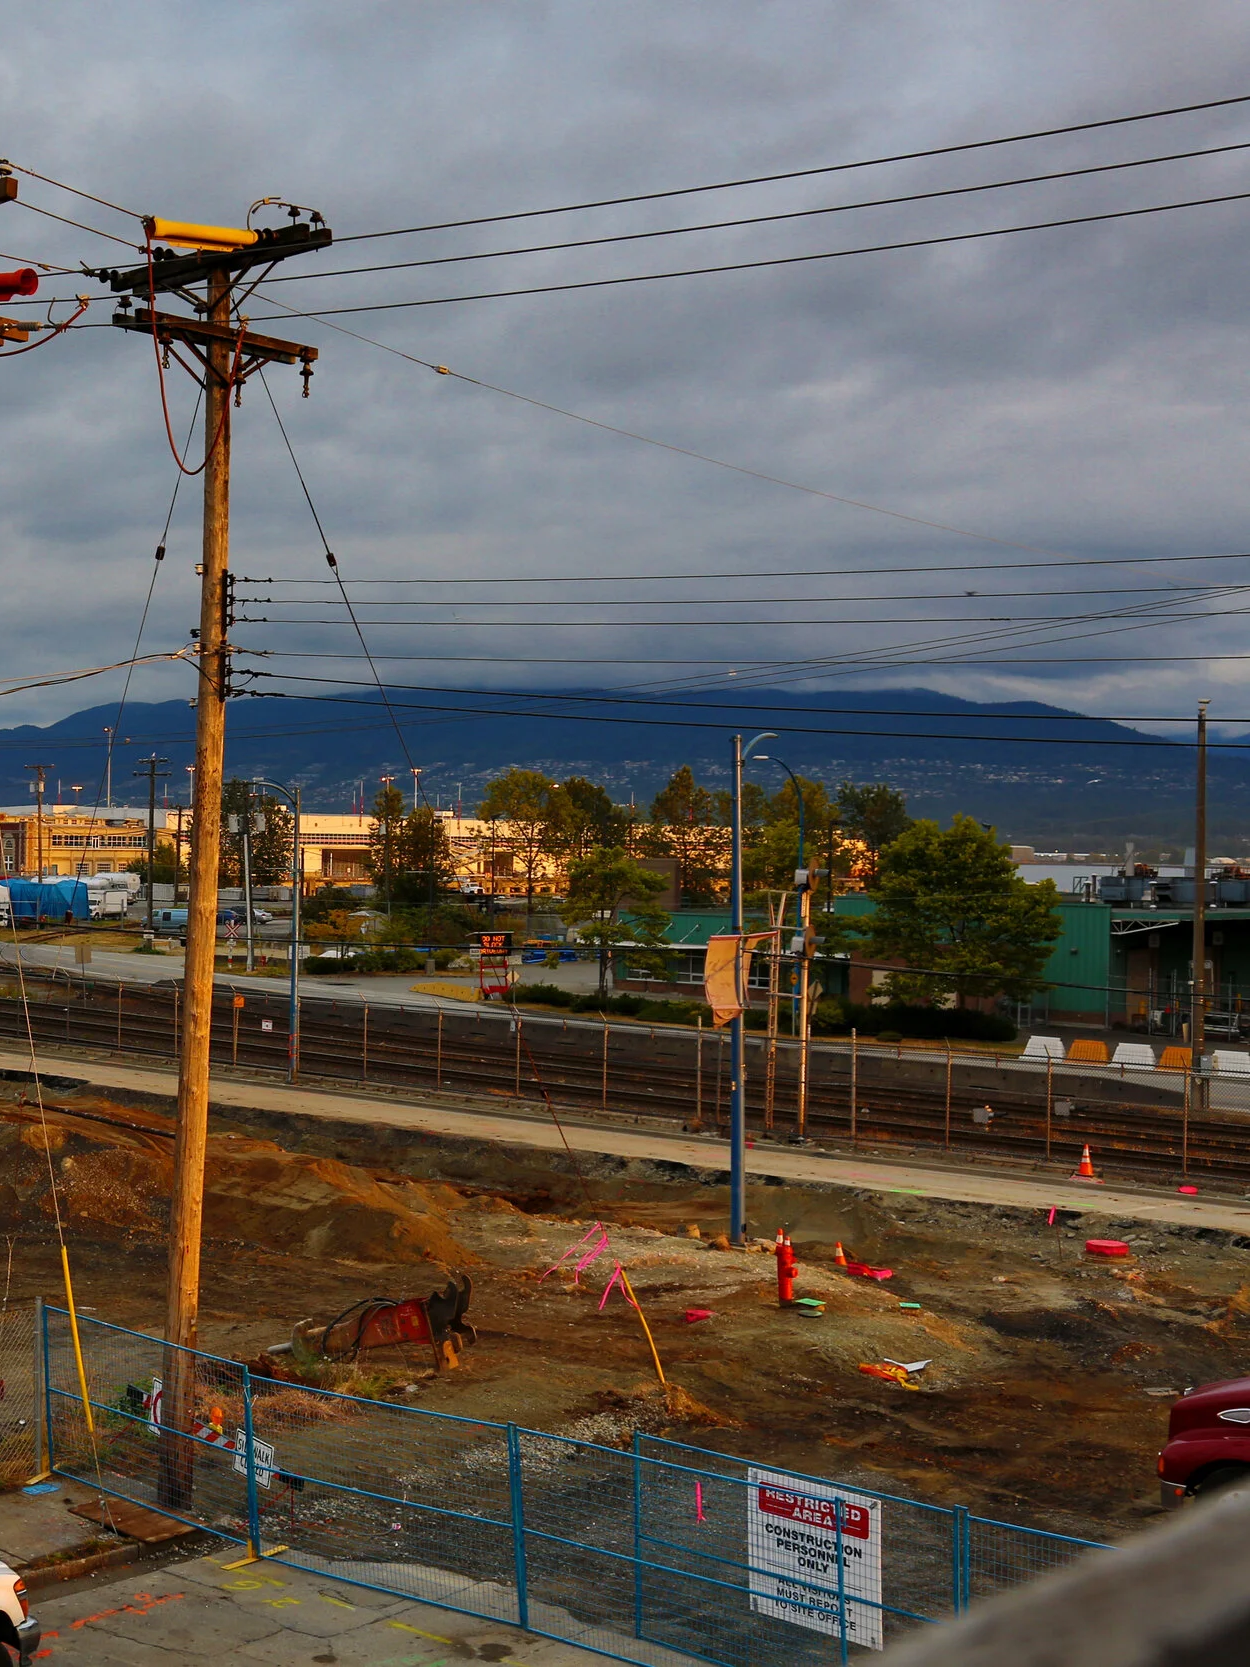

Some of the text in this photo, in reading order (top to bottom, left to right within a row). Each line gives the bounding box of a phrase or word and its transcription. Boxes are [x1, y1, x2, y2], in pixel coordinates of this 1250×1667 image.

[237, 1438, 270, 1465] SIWALK
[792, 1507, 833, 1527] AREA
[776, 1538, 851, 1569] PERSONNL
[797, 1557, 830, 1574] ONLY
[776, 1586, 853, 1618] MUST REPOT
[800, 1583, 851, 1605] VISITOS
[791, 1602, 814, 1618] SITE
[817, 1612, 857, 1632] OFFCE
